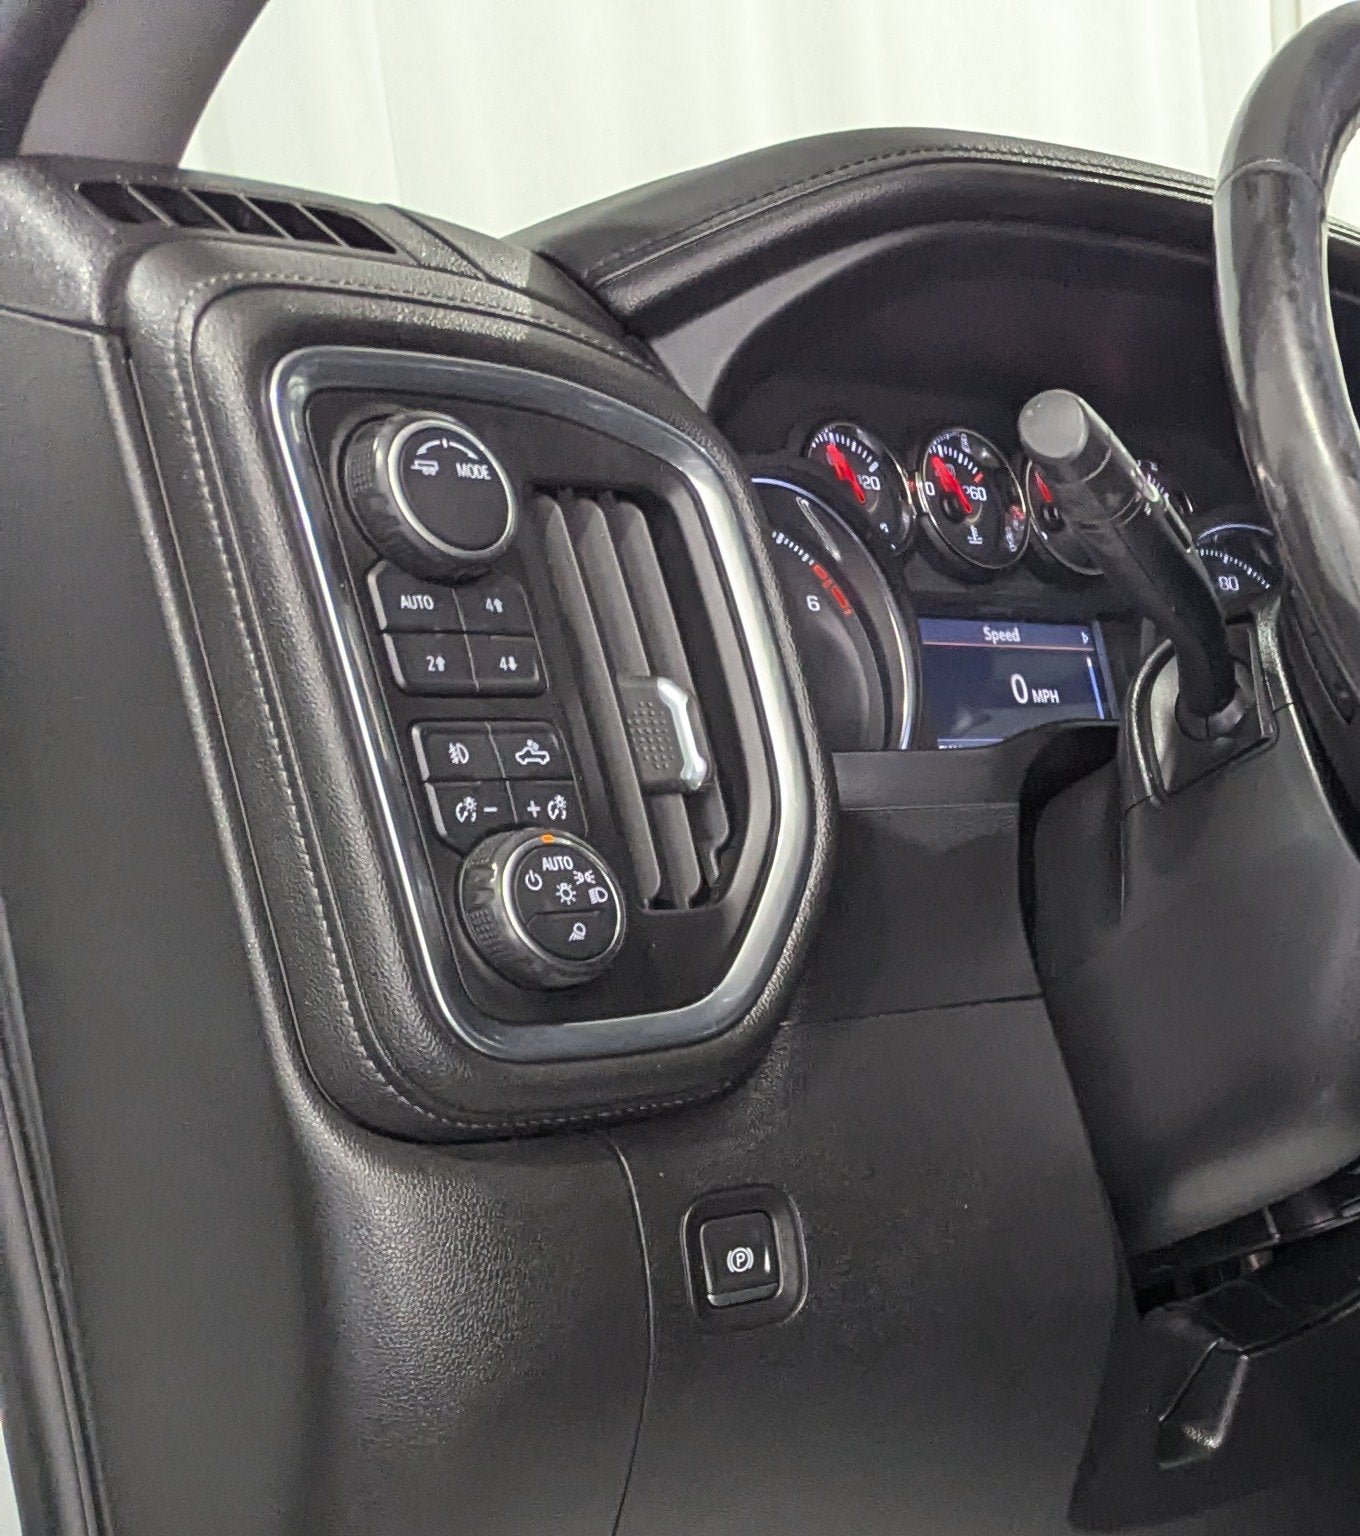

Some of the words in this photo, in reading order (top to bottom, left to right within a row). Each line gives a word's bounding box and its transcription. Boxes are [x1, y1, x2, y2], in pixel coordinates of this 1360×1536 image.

[456, 462, 491, 480] MODE
[400, 594, 434, 611] AUTO
[806, 595, 821, 612] 6
[983, 626, 1021, 645] Speed
[1010, 673, 1029, 705] 0
[1031, 689, 1060, 704] MPH
[541, 856, 574, 872] AUTO
